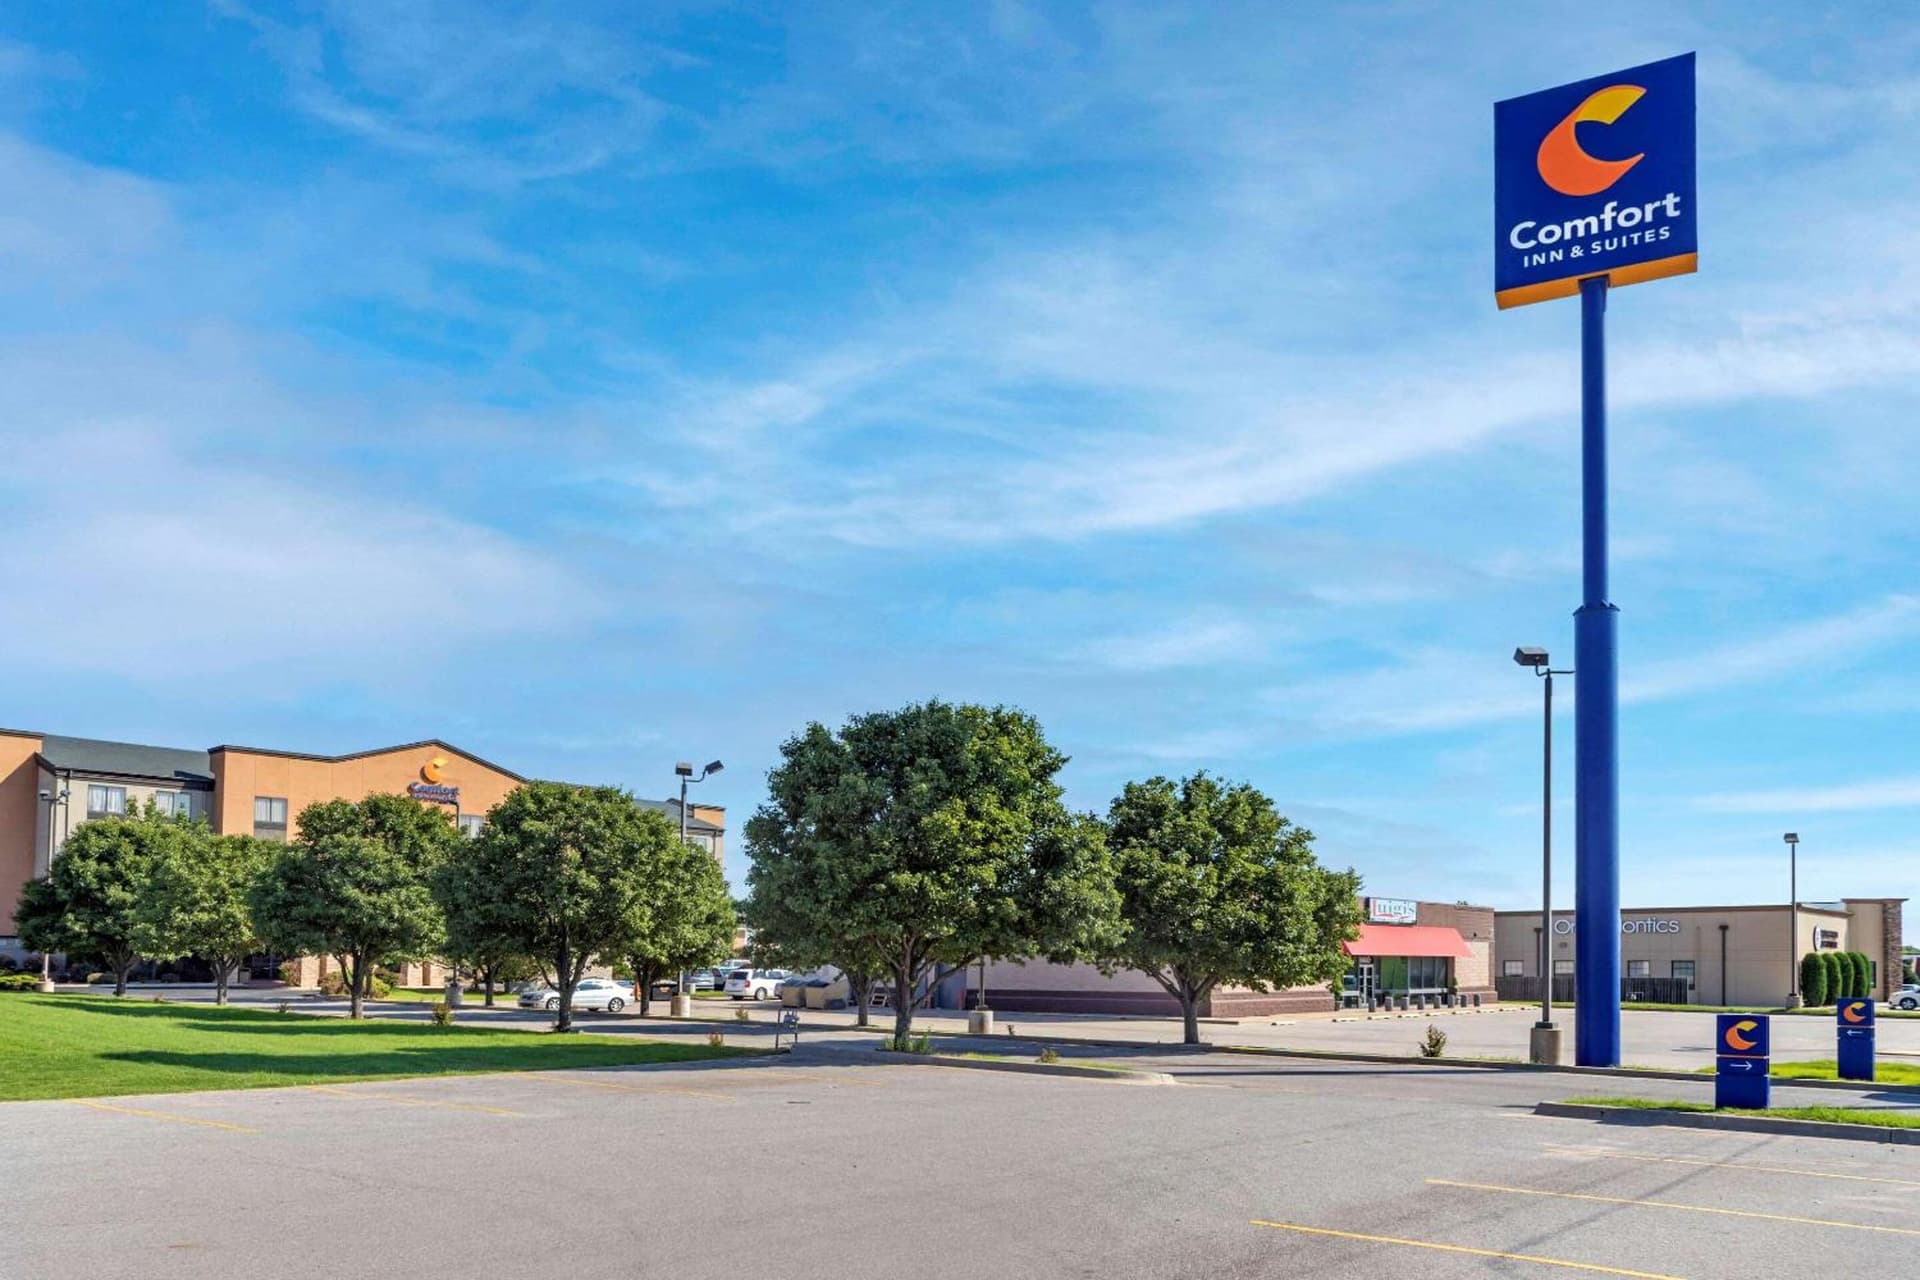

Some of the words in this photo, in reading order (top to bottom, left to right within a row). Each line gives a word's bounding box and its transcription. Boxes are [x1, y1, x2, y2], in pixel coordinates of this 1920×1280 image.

[1510, 192, 1681, 249] Comfort
[1523, 249, 1563, 268] INN
[1570, 245, 1584, 258] &
[1591, 226, 1671, 254] SUITES
[1554, 916, 1679, 934] Orontics
